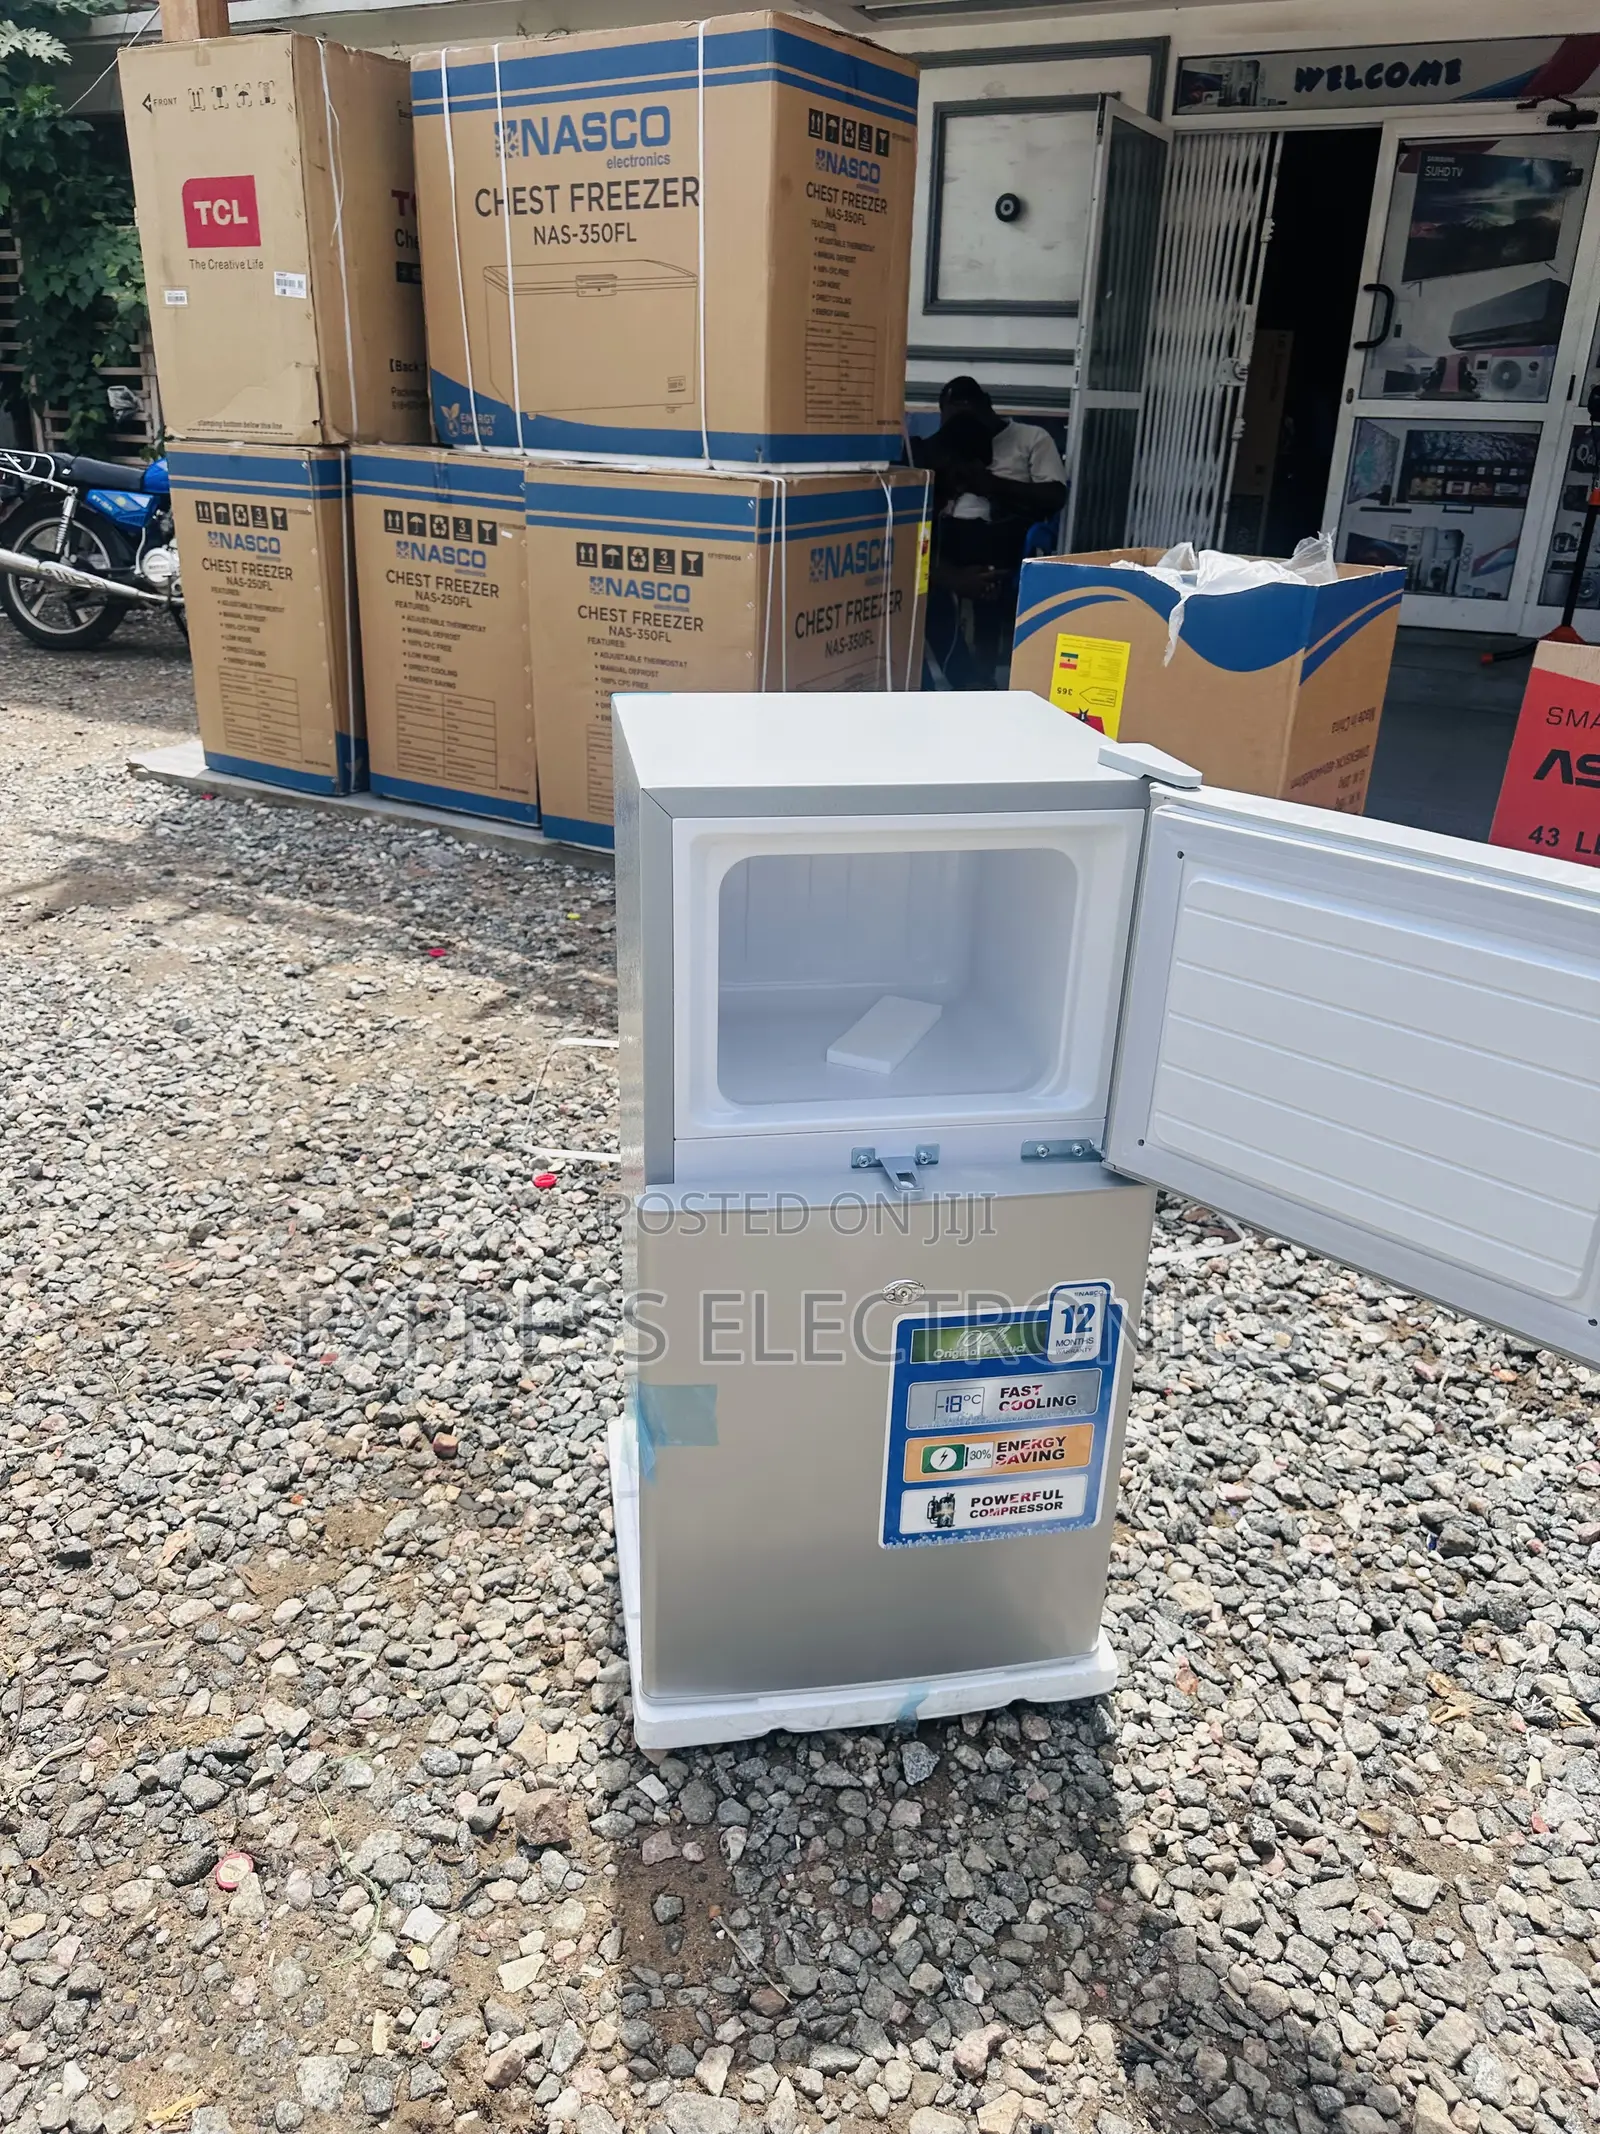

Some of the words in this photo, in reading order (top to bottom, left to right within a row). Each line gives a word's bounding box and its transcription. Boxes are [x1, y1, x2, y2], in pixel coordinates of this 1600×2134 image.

[1293, 58, 1463, 94] WELCOME
[153, 97, 178, 107] FRONT
[520, 105, 672, 157] NASCO
[606, 152, 672, 170] electronics
[825, 153, 881, 185] NASCO
[475, 184, 560, 217] CHEST
[569, 176, 701, 213] FREEZER
[806, 181, 838, 204] CHEST
[841, 189, 888, 214] FREEZER
[193, 198, 249, 226] TCL
[825, 206, 867, 226] NAS-350FL
[533, 222, 637, 246] NAS-350FL
[189, 259, 207, 270] The
[207, 259, 246, 271] Creative
[246, 258, 264, 270] Life
[219, 532, 281, 555] NASCO
[410, 542, 487, 570] NASCO
[824, 536, 895, 580] NASCO
[202, 557, 239, 574] CHEST
[241, 562, 293, 581] FREEZER
[226, 576, 273, 592] NAS-250FL
[385, 569, 431, 588] CHEST
[435, 576, 500, 599] FREEZER
[605, 577, 691, 604] NASCO
[414, 590, 473, 609] NAS-250FL
[577, 604, 628, 623] CHEST
[632, 610, 704, 632] FREEZER
[795, 604, 842, 639] CHEST
[586, 635, 626, 649] FEATURES:
[608, 625, 673, 643] NAS-350FL
[825, 630, 875, 659] NAS-350FL
[600, 651, 643, 664] ADJUSTABLE
[643, 656, 688, 669] THERMOSTAT
[628, 667, 659, 678] DEFROST
[1056, 686, 1073, 697] 365
[1528, 825, 1560, 848] 43
[1078, 1290, 1104, 1298] NASCO
[1061, 1303, 1096, 1335] 12
[933, 1345, 980, 1360] Original
[983, 1342, 1027, 1356] Product
[1055, 1347, 1093, 1356] WARRANTY
[1056, 1336, 1094, 1348] MONTHS
[1000, 1384, 1043, 1398] FAST
[999, 1395, 1077, 1412] COOLING
[970, 1448, 991, 1460] 30%
[997, 1436, 1067, 1453] ENERGY
[996, 1449, 1065, 1466] SAVING
[970, 1489, 1064, 1508] POWERFUL
[970, 1501, 1063, 1519] COMPRESSOR
